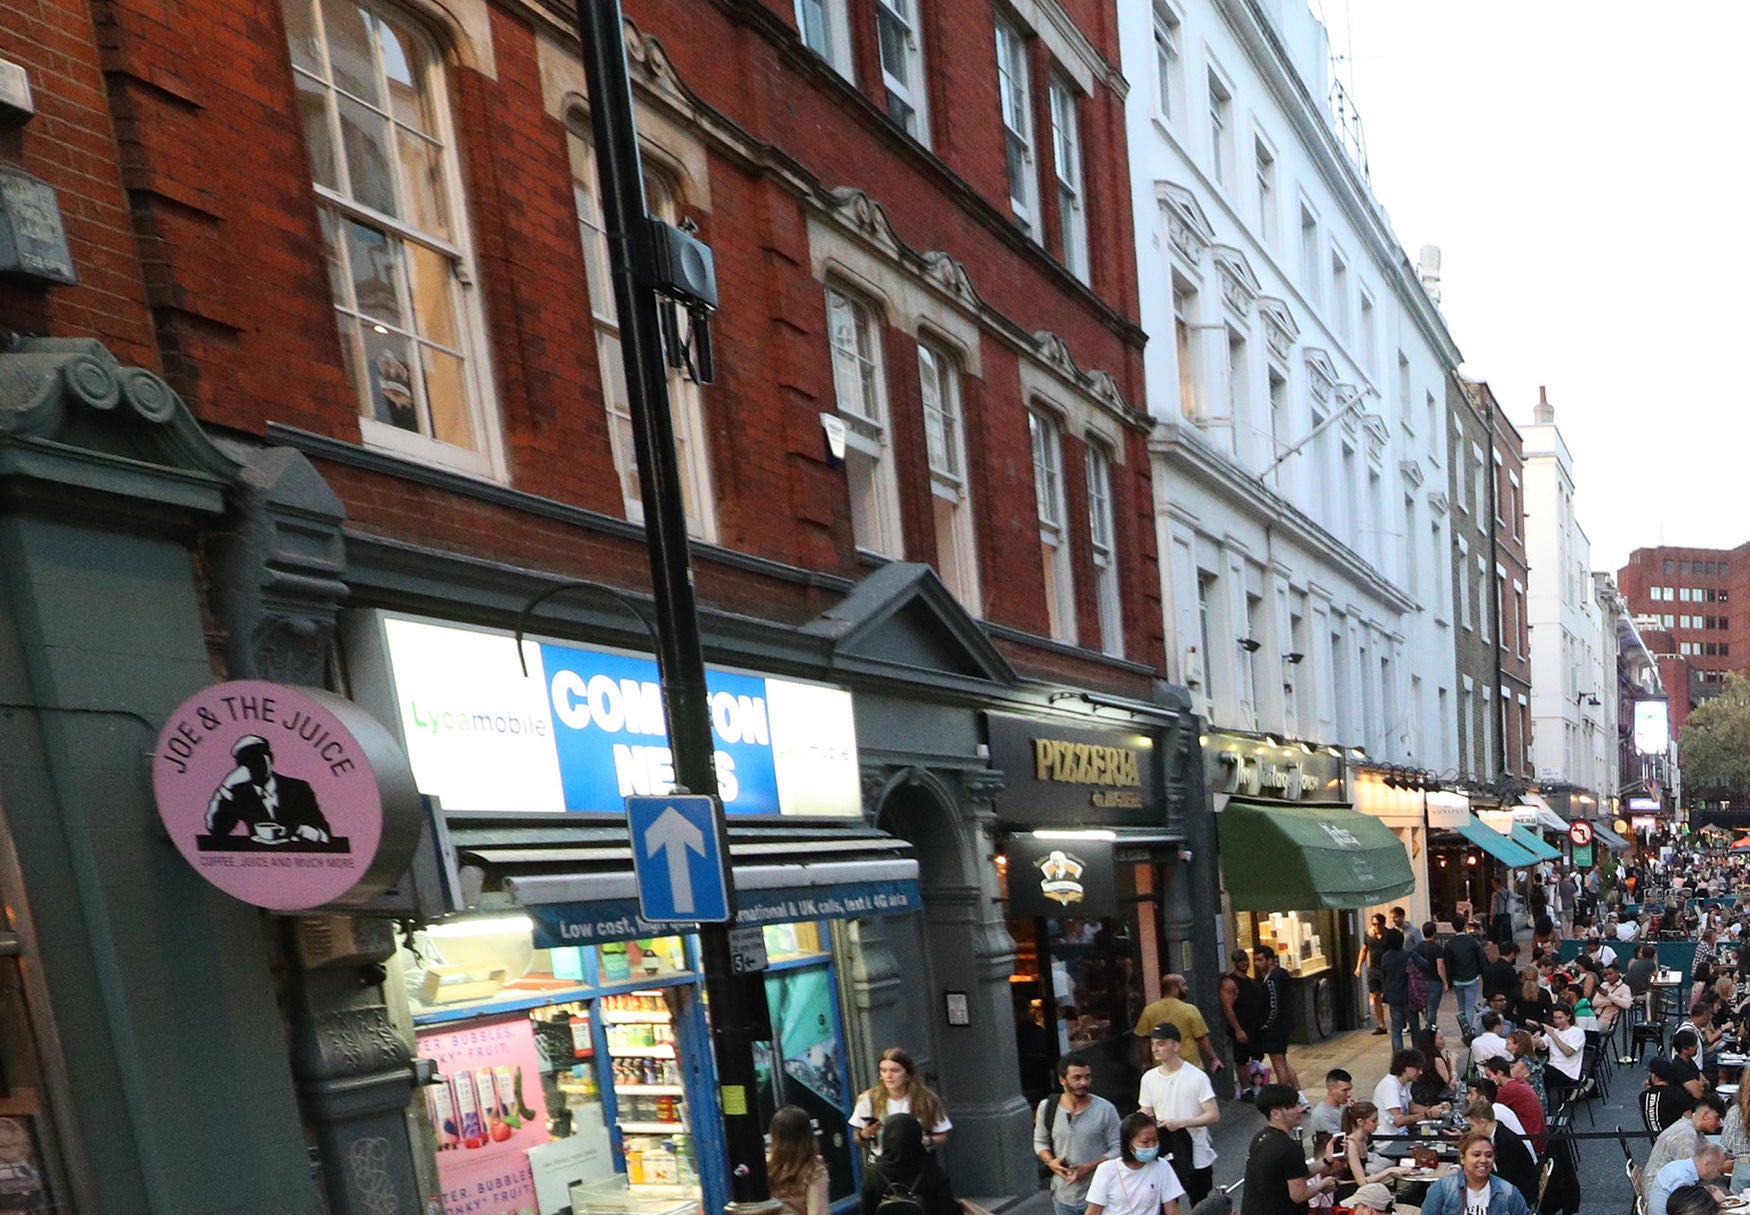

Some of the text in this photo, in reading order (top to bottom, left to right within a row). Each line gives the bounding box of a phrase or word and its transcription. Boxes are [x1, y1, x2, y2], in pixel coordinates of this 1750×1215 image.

[411, 701, 546, 736] Lycamobile
[551, 669, 769, 745] COMON
[163, 695, 355, 777] JOE & THE JUICE
[613, 743, 739, 802] NES
[1035, 737, 1141, 787] PIZZERIA
[240, 857, 268, 868] JUICE
[271, 857, 291, 868] AND
[294, 857, 324, 868] MUCH
[326, 858, 354, 868] MORE
[738, 901, 788, 922] rnational
[799, 900, 818, 915] UK
[818, 898, 846, 914] calls,
[873, 894, 889, 908] 4G
[560, 920, 593, 939] Low
[596, 917, 635, 935] cost,
[441, 1188, 471, 1203] TER.
